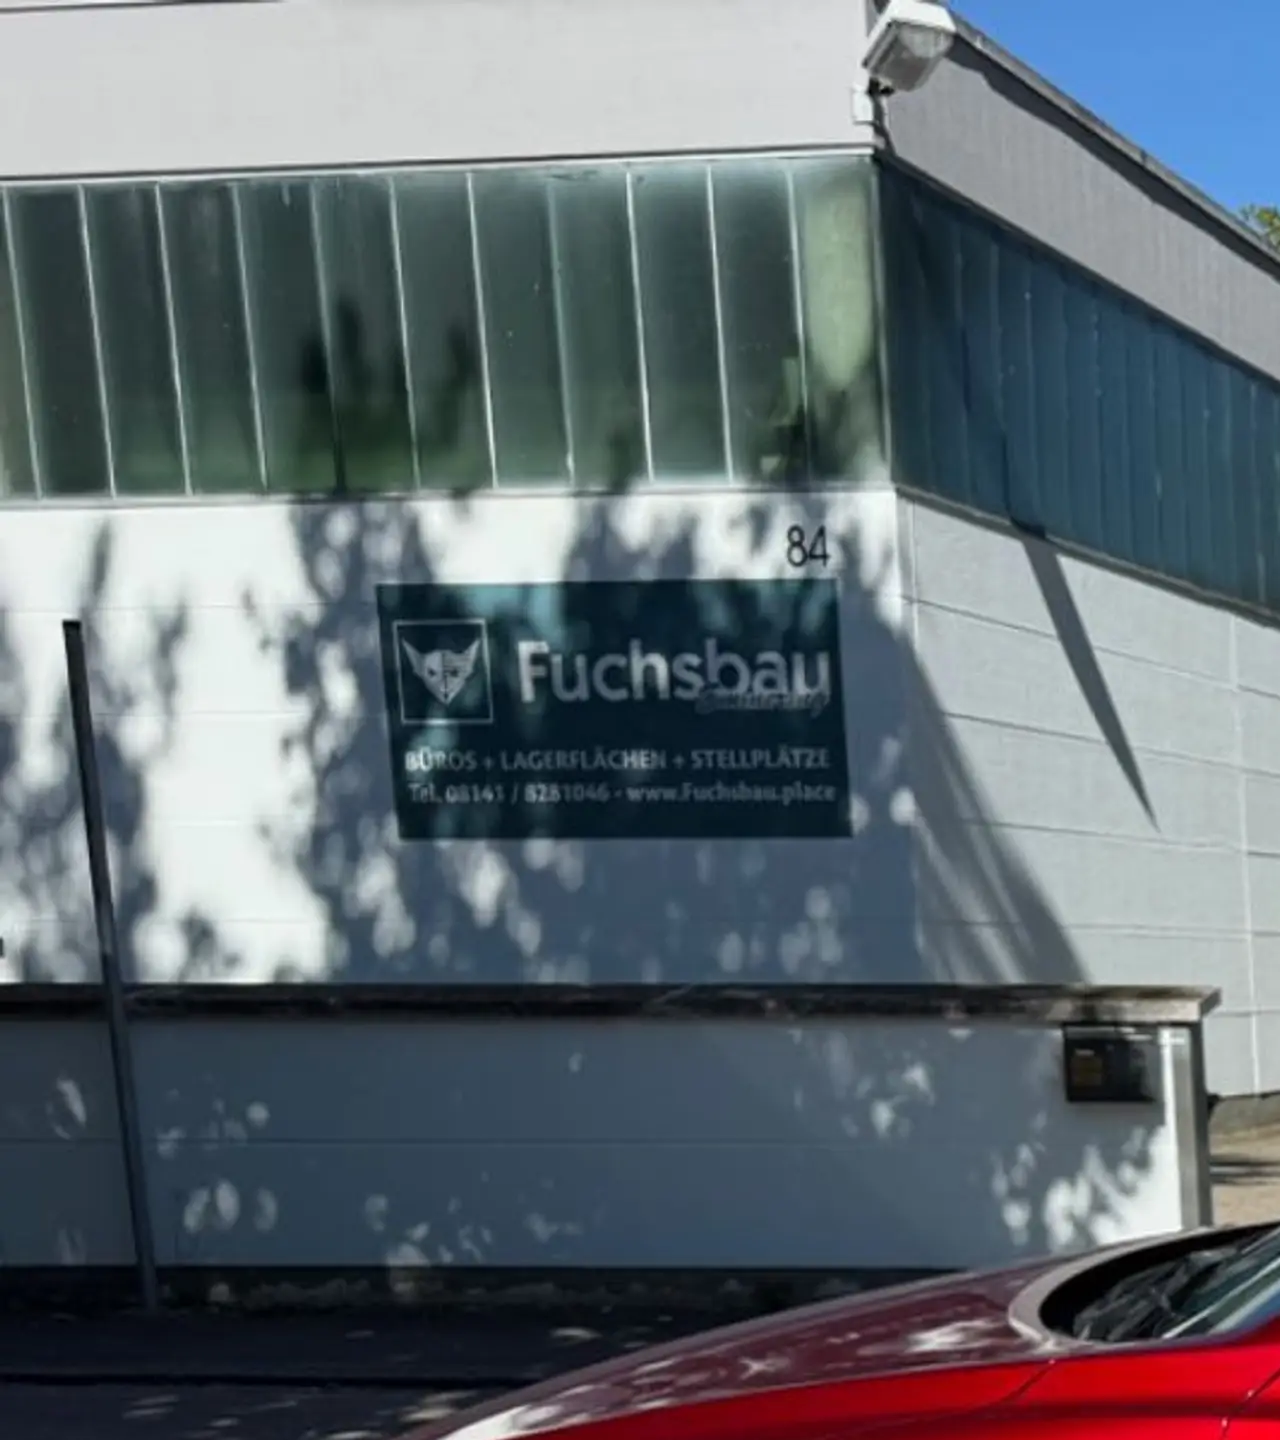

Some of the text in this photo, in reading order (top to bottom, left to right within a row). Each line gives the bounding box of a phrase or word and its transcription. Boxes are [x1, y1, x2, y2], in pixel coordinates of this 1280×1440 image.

[787, 525, 830, 567] 84
[517, 638, 830, 703] Fuchsbau
[405, 746, 477, 772] BÜROS
[501, 746, 667, 771] LAGERFLÄCHEN
[691, 744, 830, 770] STELLPLÄTZE
